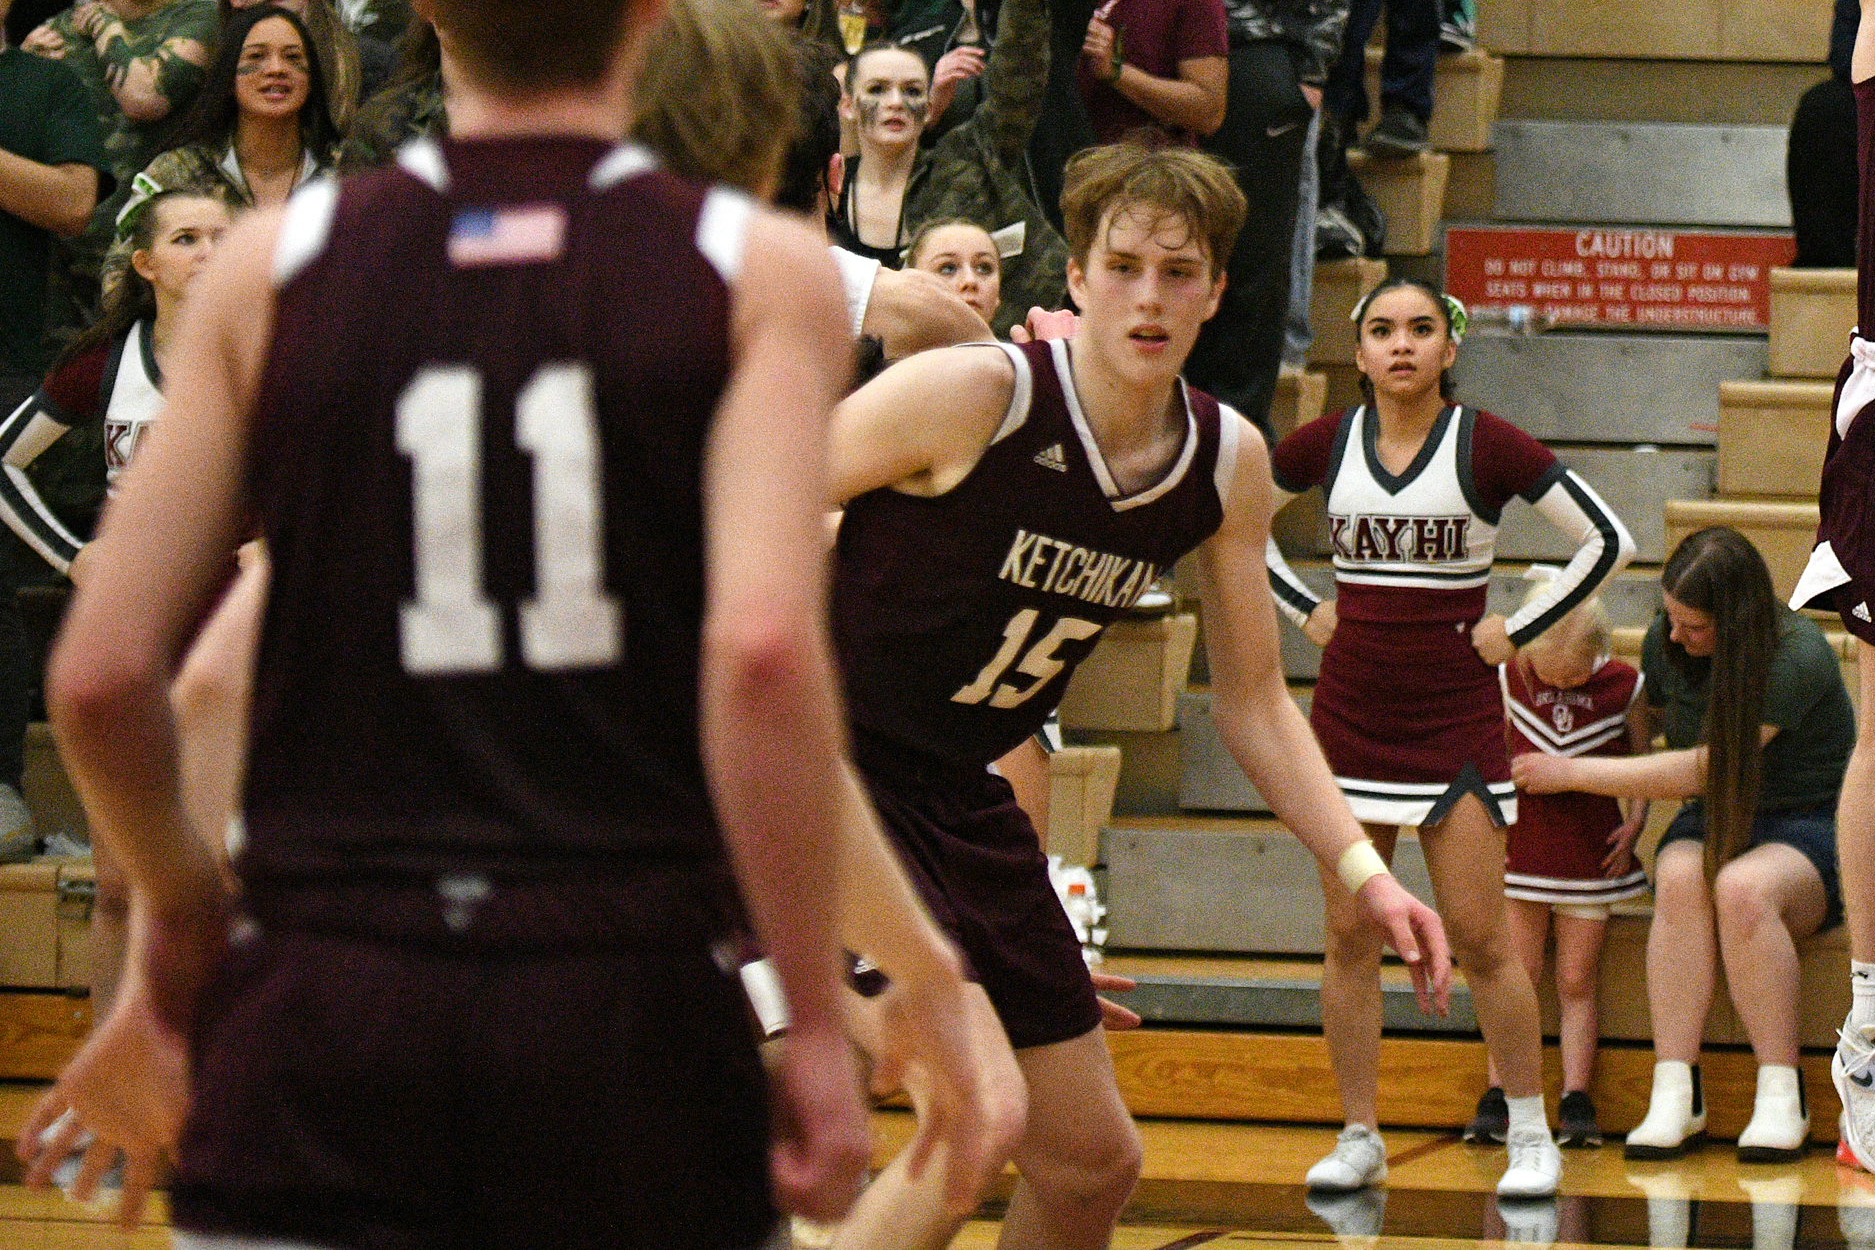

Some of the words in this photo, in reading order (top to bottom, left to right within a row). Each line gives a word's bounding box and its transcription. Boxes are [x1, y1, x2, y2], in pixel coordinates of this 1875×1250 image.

[1575, 232, 1675, 258] CAUTION
[1484, 259, 1506, 276] DO
[1508, 259, 1537, 276] NOT
[1650, 261, 1672, 280] OR
[1675, 262, 1699, 280] SIT
[1702, 263, 1725, 282] ON
[1485, 279, 1527, 298] SEATS
[1532, 280, 1572, 299] WHEN
[1576, 281, 1595, 299] IN
[1599, 281, 1624, 301] THE
[1629, 283, 1684, 302] CLOSED
[1605, 304, 1631, 324] THE
[395, 362, 625, 672] 11
[1329, 516, 1469, 563] KAYHI
[950, 608, 1103, 709] 15
